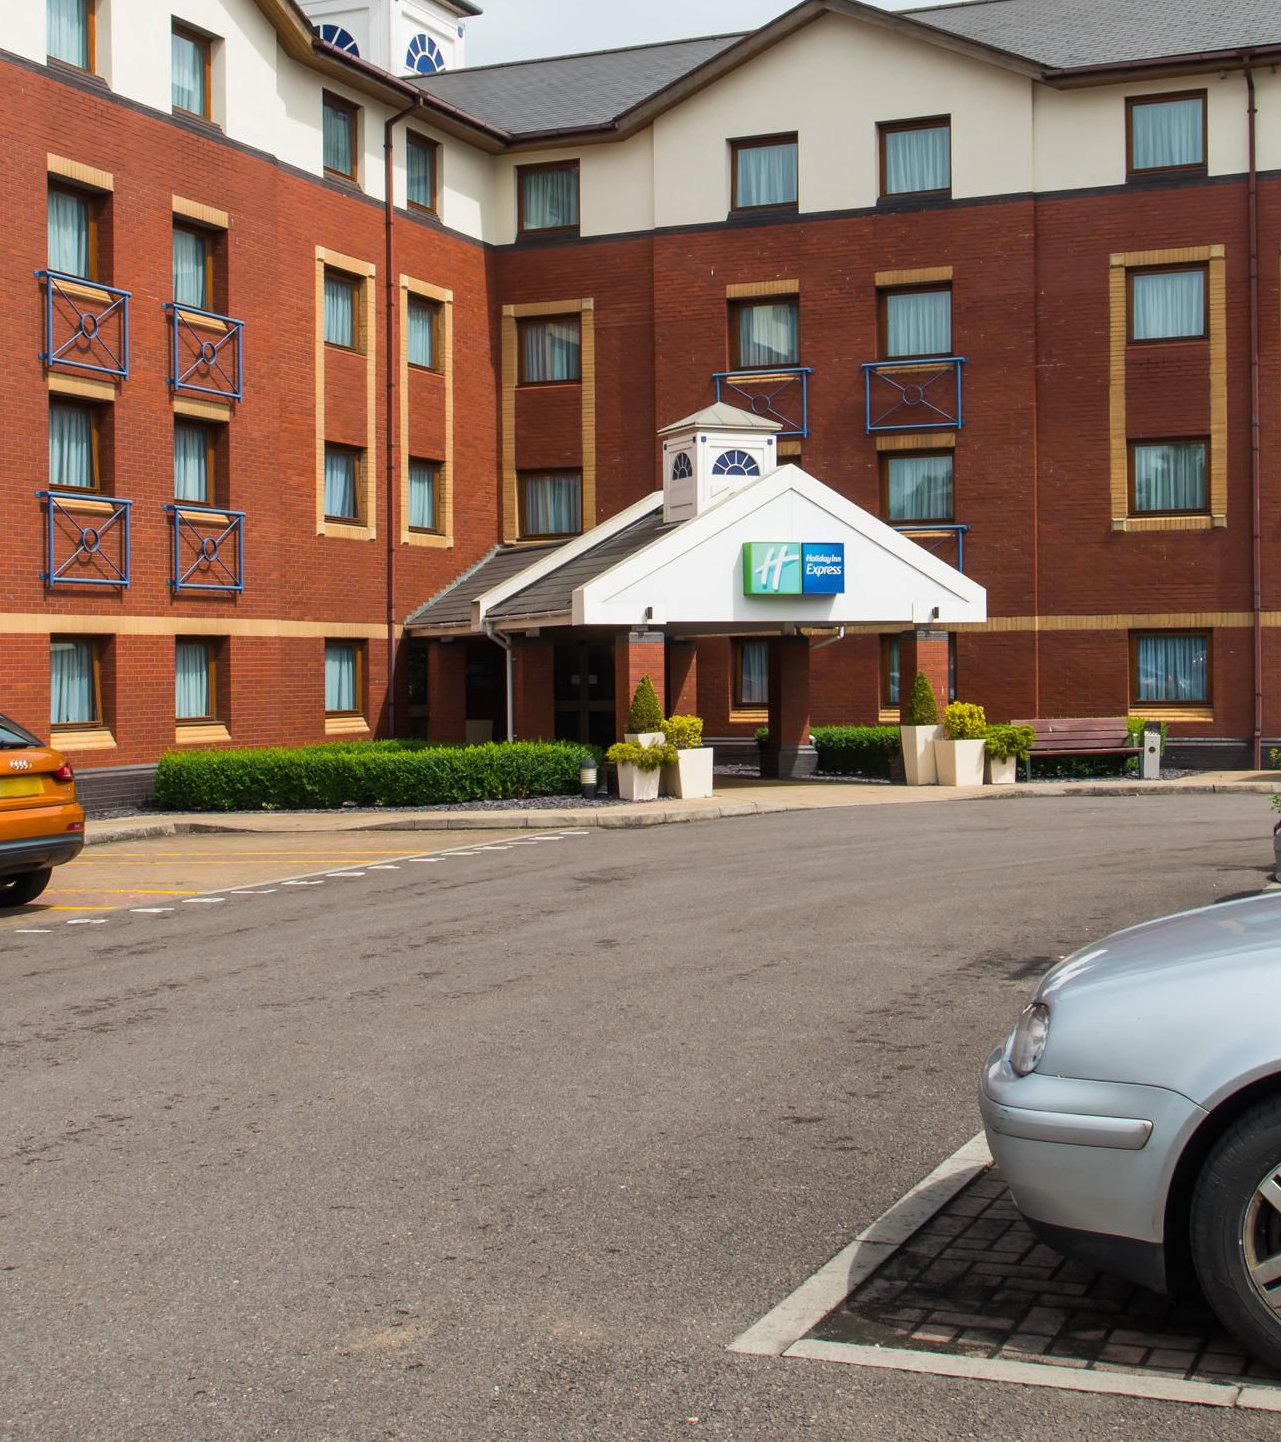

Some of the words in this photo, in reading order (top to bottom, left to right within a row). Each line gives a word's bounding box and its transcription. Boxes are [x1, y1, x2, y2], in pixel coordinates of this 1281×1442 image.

[806, 554, 831, 565] Holiday
[831, 554, 842, 563] Inn
[806, 563, 842, 577] Express
